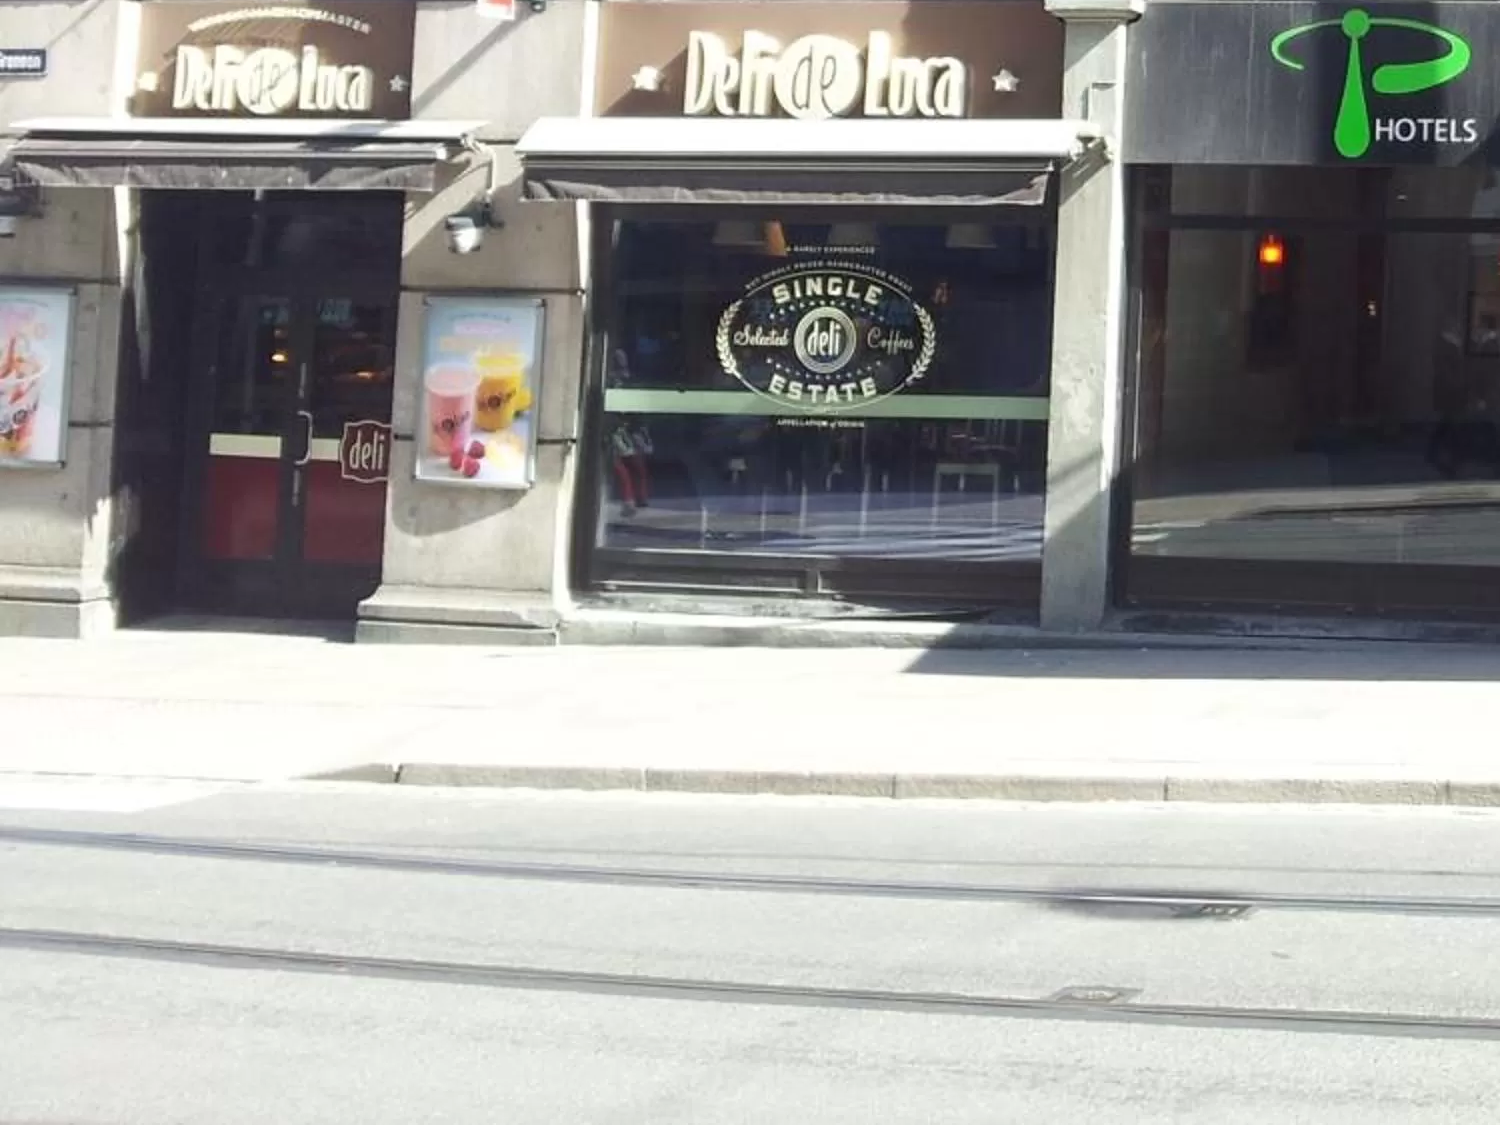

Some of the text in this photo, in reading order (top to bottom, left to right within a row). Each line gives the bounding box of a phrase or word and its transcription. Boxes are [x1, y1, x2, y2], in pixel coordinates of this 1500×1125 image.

[298, 44, 374, 110] Luca
[864, 30, 966, 117] Luca
[1375, 118, 1477, 143] HOTELS
[772, 277, 883, 305] SINGLE
[733, 320, 914, 356] Selected deli Coffees
[768, 373, 877, 404] ESTATE
[349, 430, 385, 470] deli
